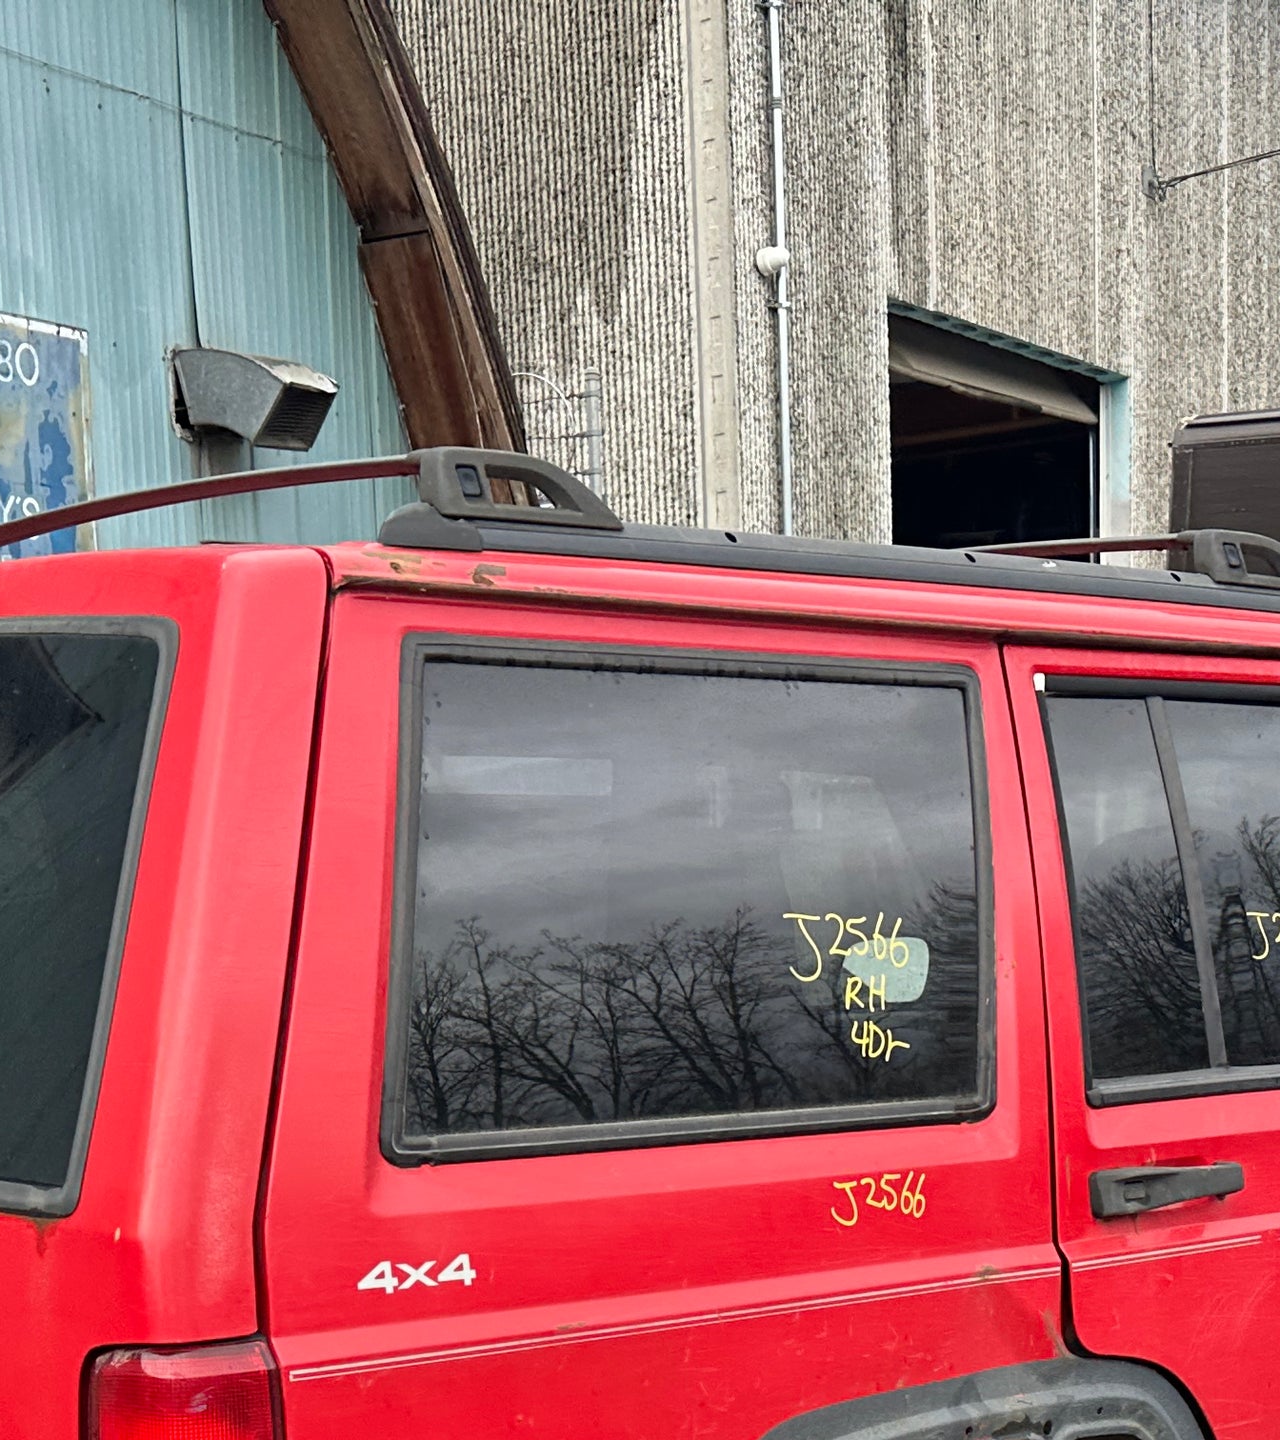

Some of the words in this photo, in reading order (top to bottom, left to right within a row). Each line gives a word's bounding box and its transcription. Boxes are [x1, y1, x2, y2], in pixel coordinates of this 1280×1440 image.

[781, 911, 910, 983] J2566
[844, 973, 887, 1013] RH
[830, 1169, 927, 1228] J2566
